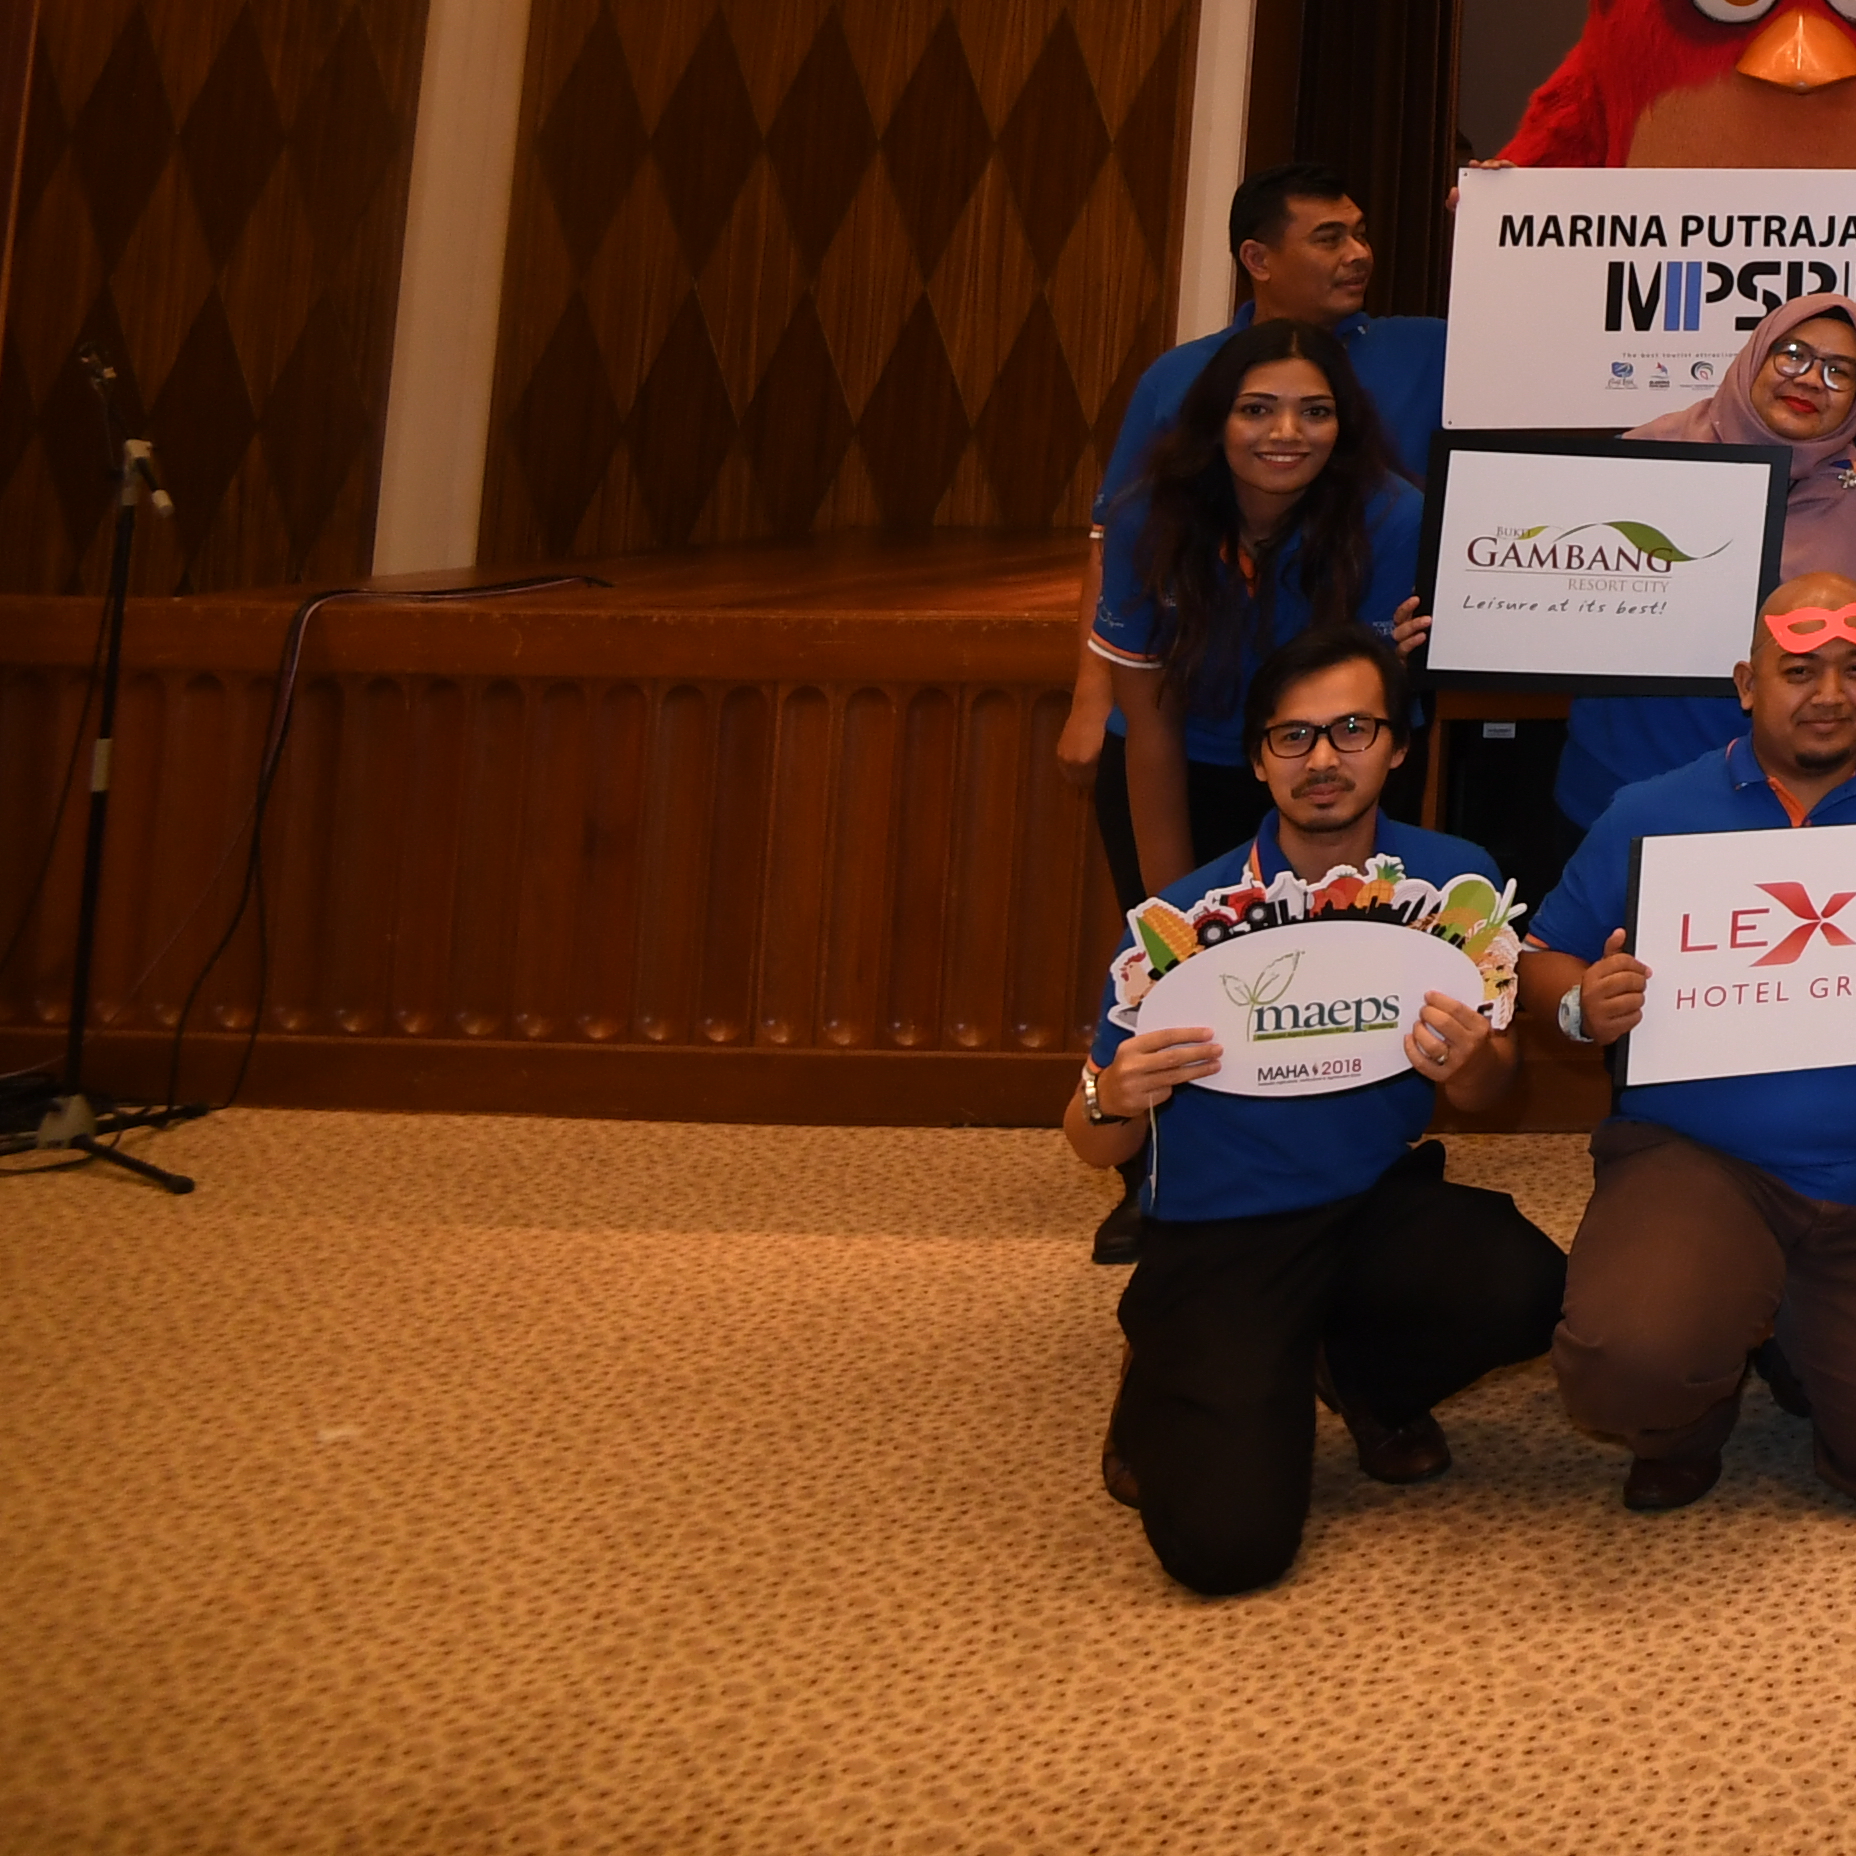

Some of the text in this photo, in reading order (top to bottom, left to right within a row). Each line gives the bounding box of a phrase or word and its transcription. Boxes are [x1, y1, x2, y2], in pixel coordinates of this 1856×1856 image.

[1498, 214, 1669, 249] MARINA
[1495, 525, 1535, 539] BUKIT
[1466, 535, 1674, 575] GAMBANG
[1567, 578, 1671, 593] RESORT CITY
[1462, 595, 1669, 617] Leisure at its best!
[1675, 983, 1790, 1010] HOTEL
[1252, 993, 1401, 1035] maeps
[1258, 1062, 1310, 1083] MAHA
[1321, 1058, 1363, 1076] 2018
